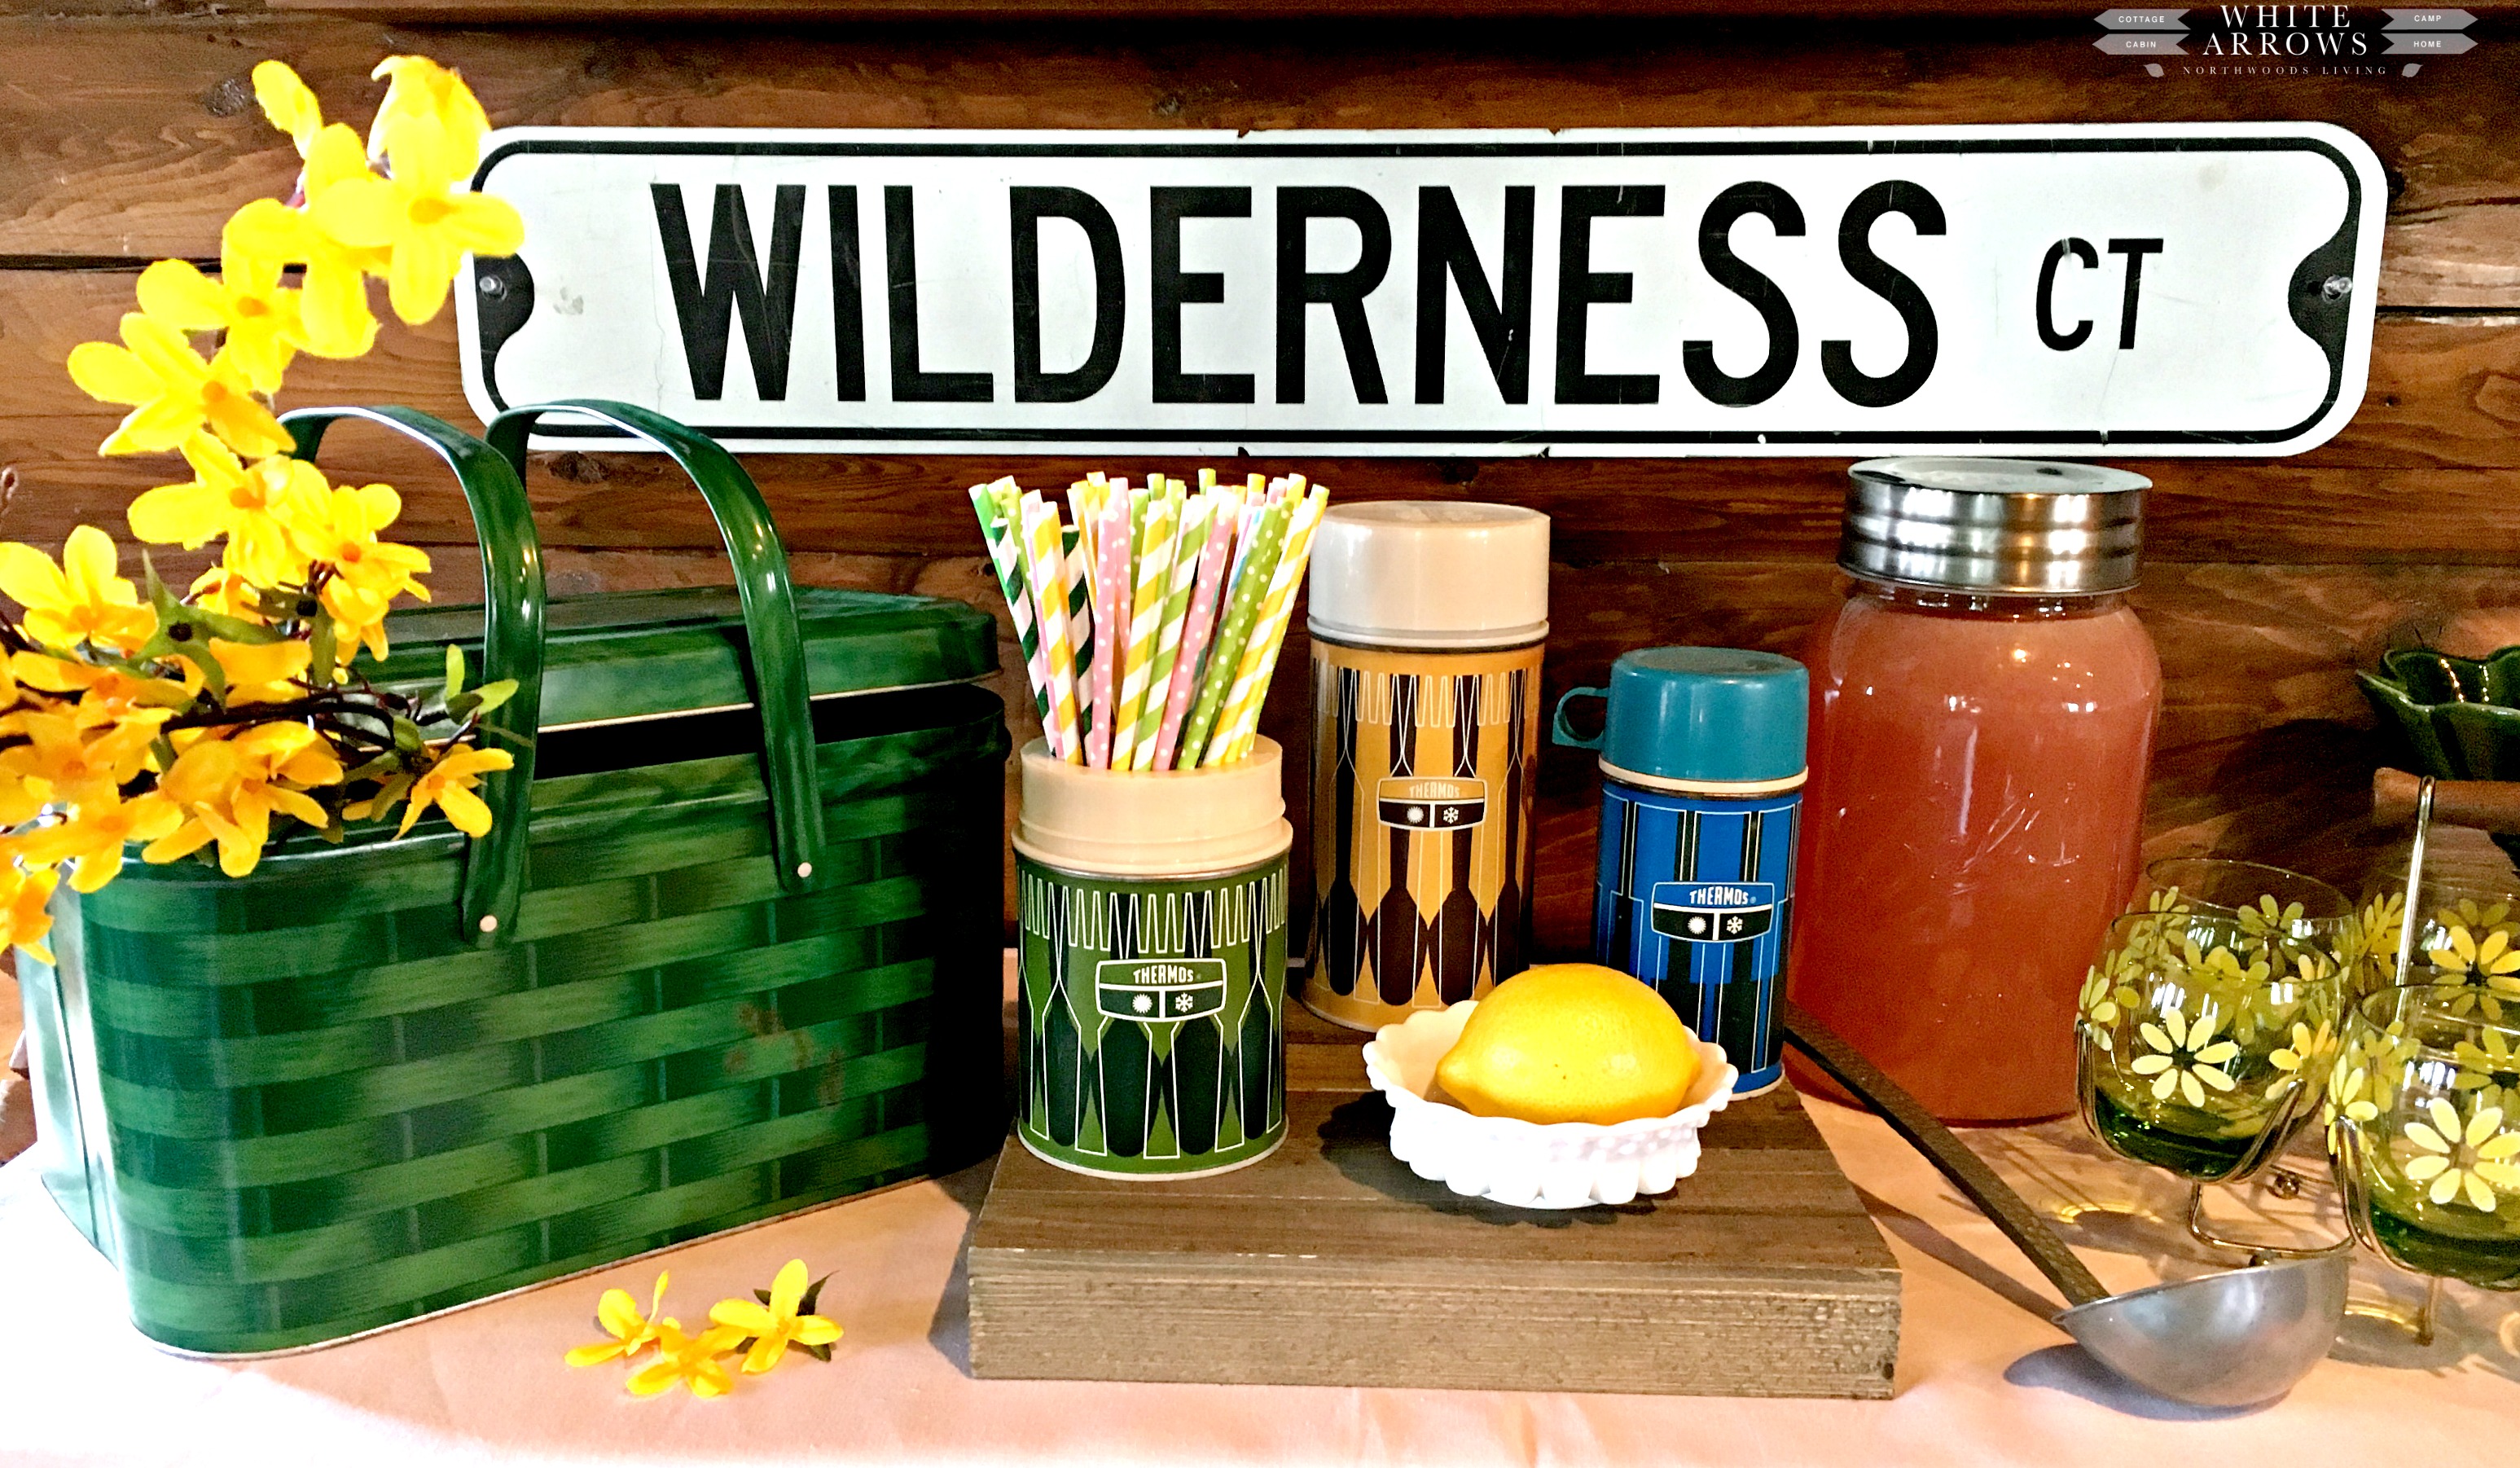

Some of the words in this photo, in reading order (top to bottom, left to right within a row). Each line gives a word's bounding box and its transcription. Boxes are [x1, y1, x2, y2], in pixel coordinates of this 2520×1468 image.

[651, 181, 1948, 409] WILDERNESS
[2035, 238, 2164, 352] CT
[1409, 781, 1460, 798] THERMOS
[1133, 965, 1194, 984] THERMOS
